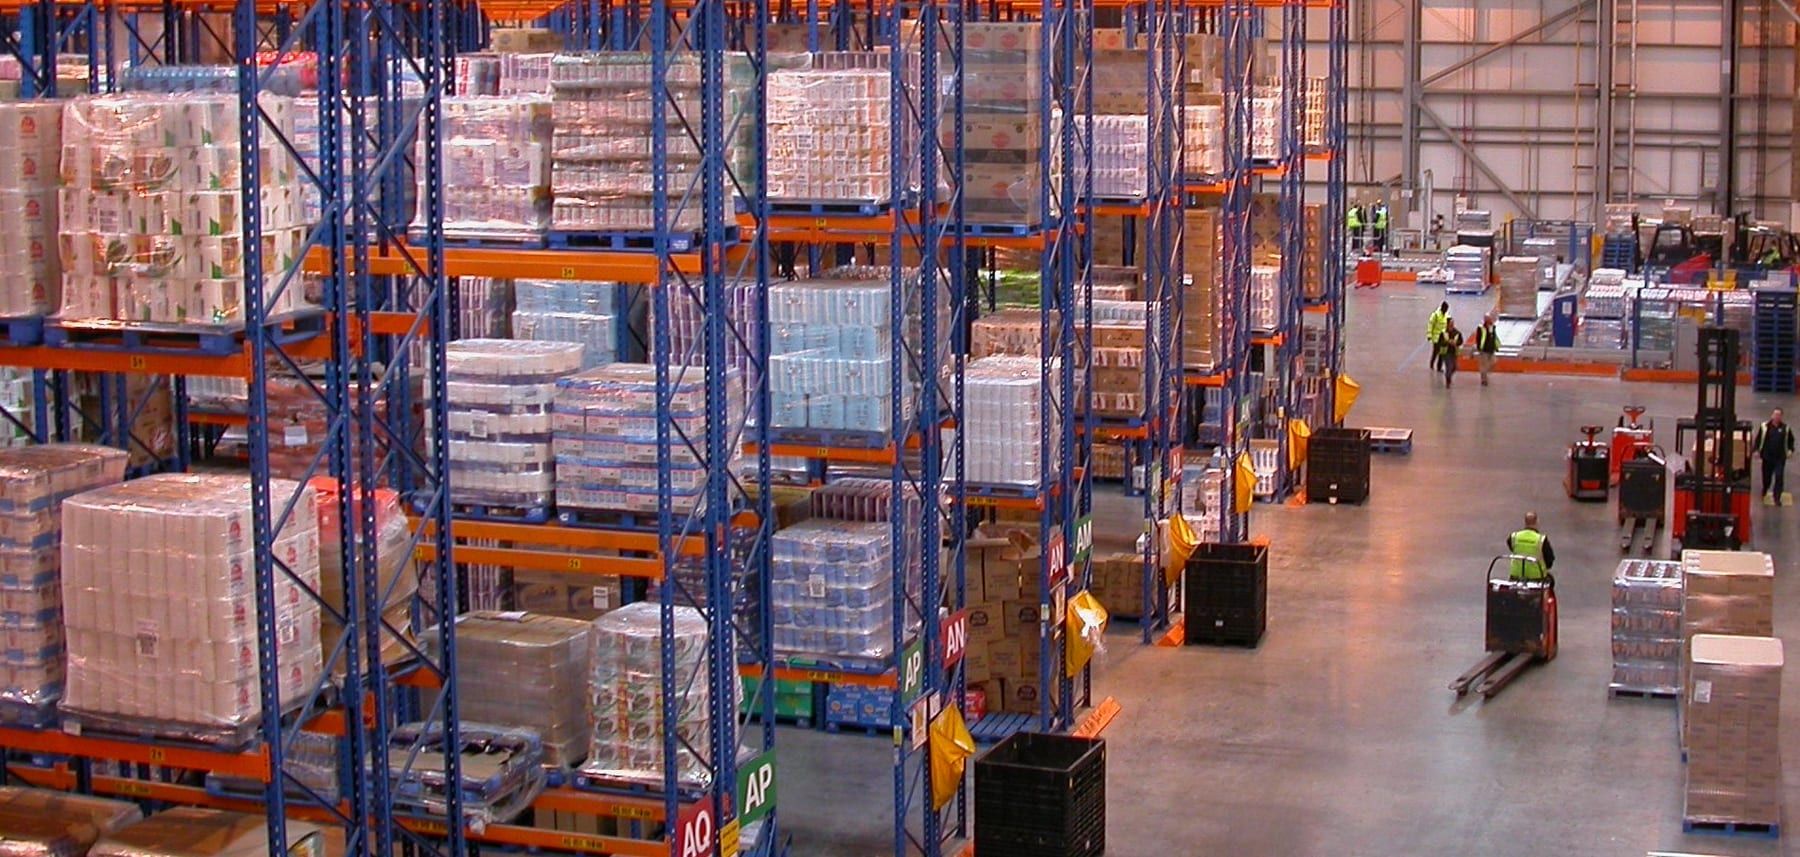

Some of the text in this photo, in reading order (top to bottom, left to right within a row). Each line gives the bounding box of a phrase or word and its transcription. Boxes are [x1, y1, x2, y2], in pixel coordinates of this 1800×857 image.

[1076, 520, 1092, 553] AM
[1050, 542, 1064, 576] AN
[946, 617, 965, 659] AN
[903, 651, 920, 692] AP
[744, 763, 773, 815] AP
[682, 809, 711, 857] AQ
